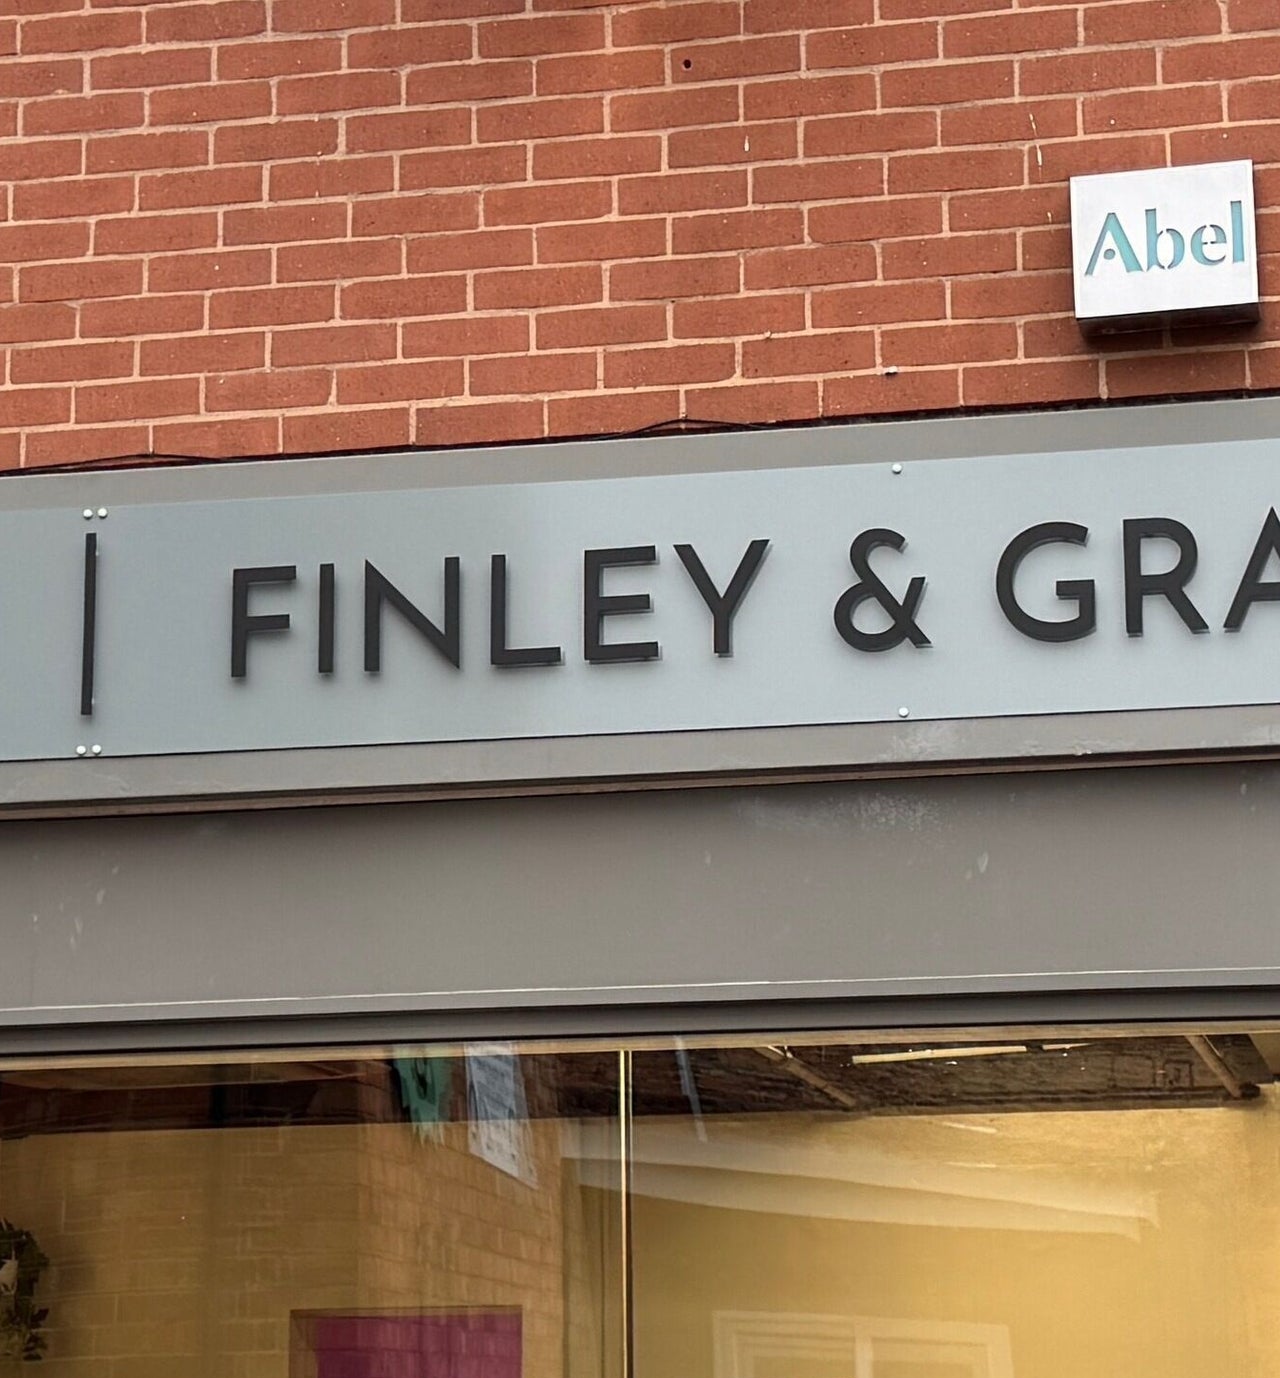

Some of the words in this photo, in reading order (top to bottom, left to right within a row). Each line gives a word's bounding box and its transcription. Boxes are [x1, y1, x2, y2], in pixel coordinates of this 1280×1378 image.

[1084, 200, 1246, 277] Abel
[230, 539, 770, 683] FINLEY
[833, 527, 932, 653] &
